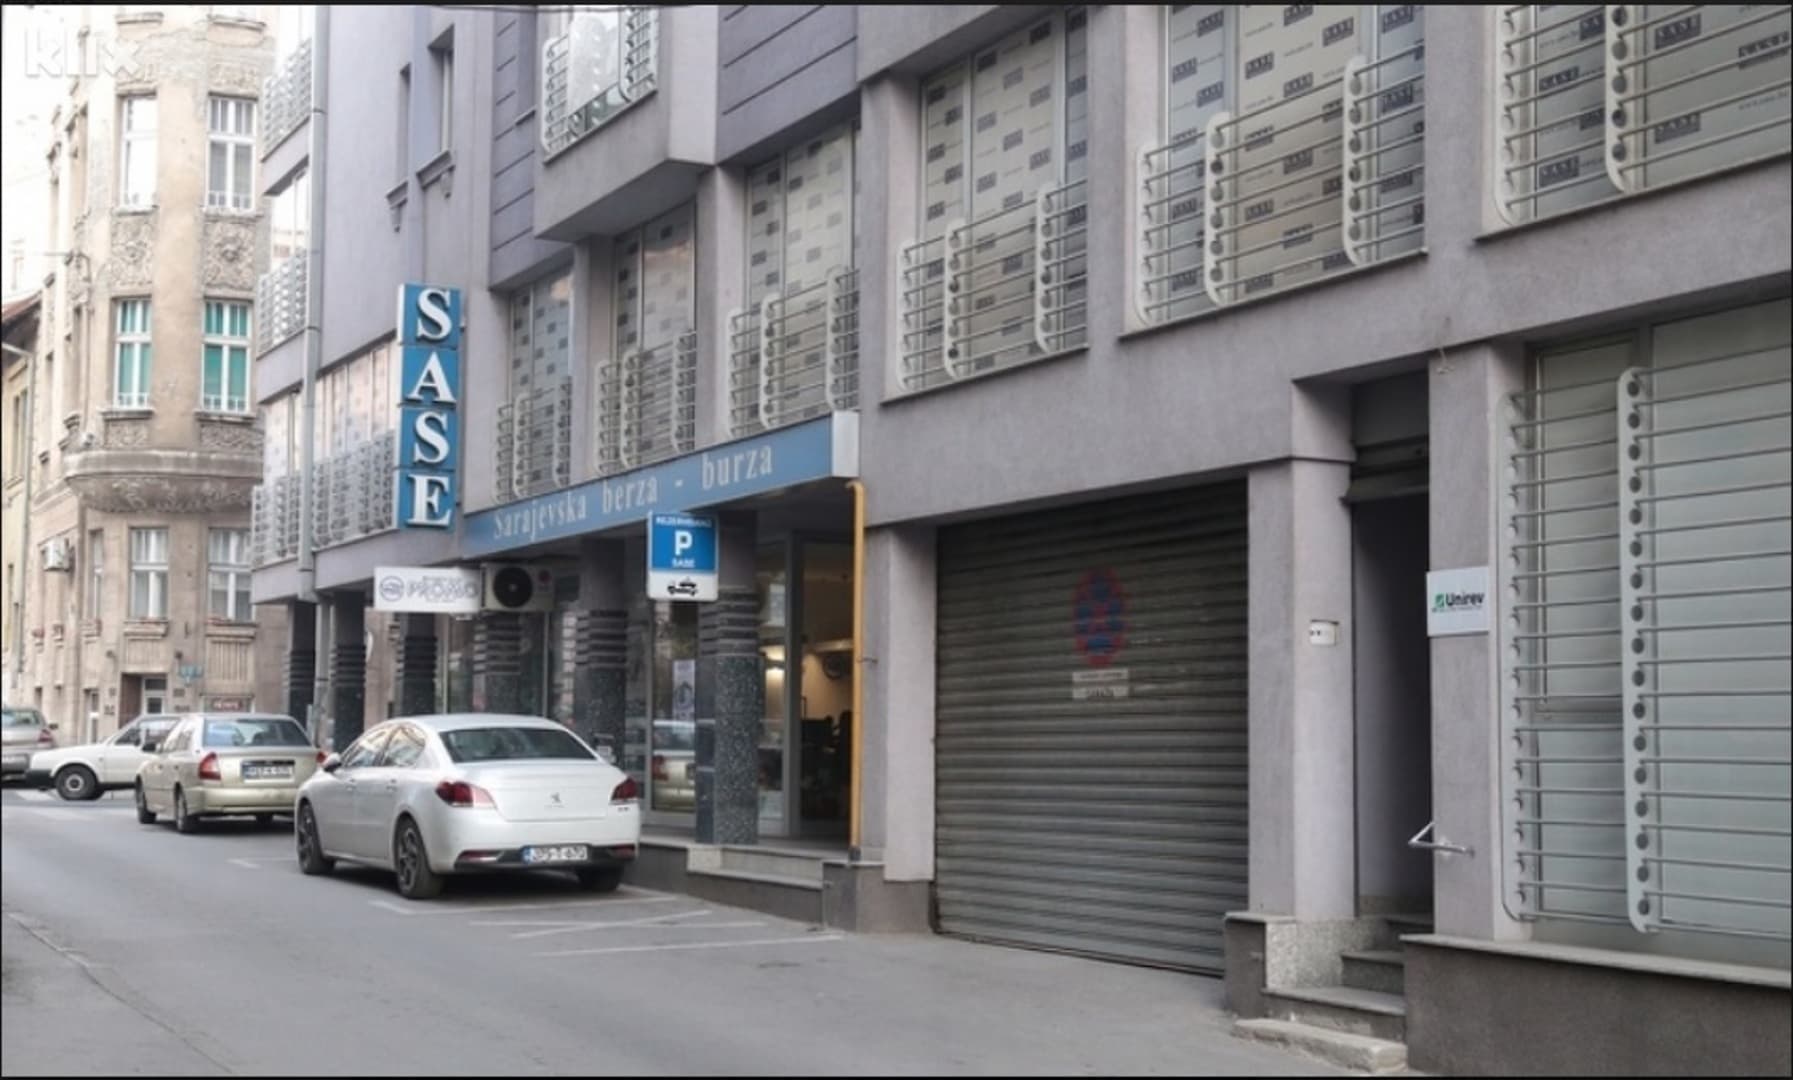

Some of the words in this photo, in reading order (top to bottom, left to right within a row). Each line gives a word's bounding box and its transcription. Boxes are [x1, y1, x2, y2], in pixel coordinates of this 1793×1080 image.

[407, 287, 457, 527] SASE
[493, 490, 587, 540] Sarajevska
[602, 476, 659, 514] berza
[702, 445, 773, 490] burza
[674, 530, 693, 556] P
[1445, 591, 1485, 606] Unirev
